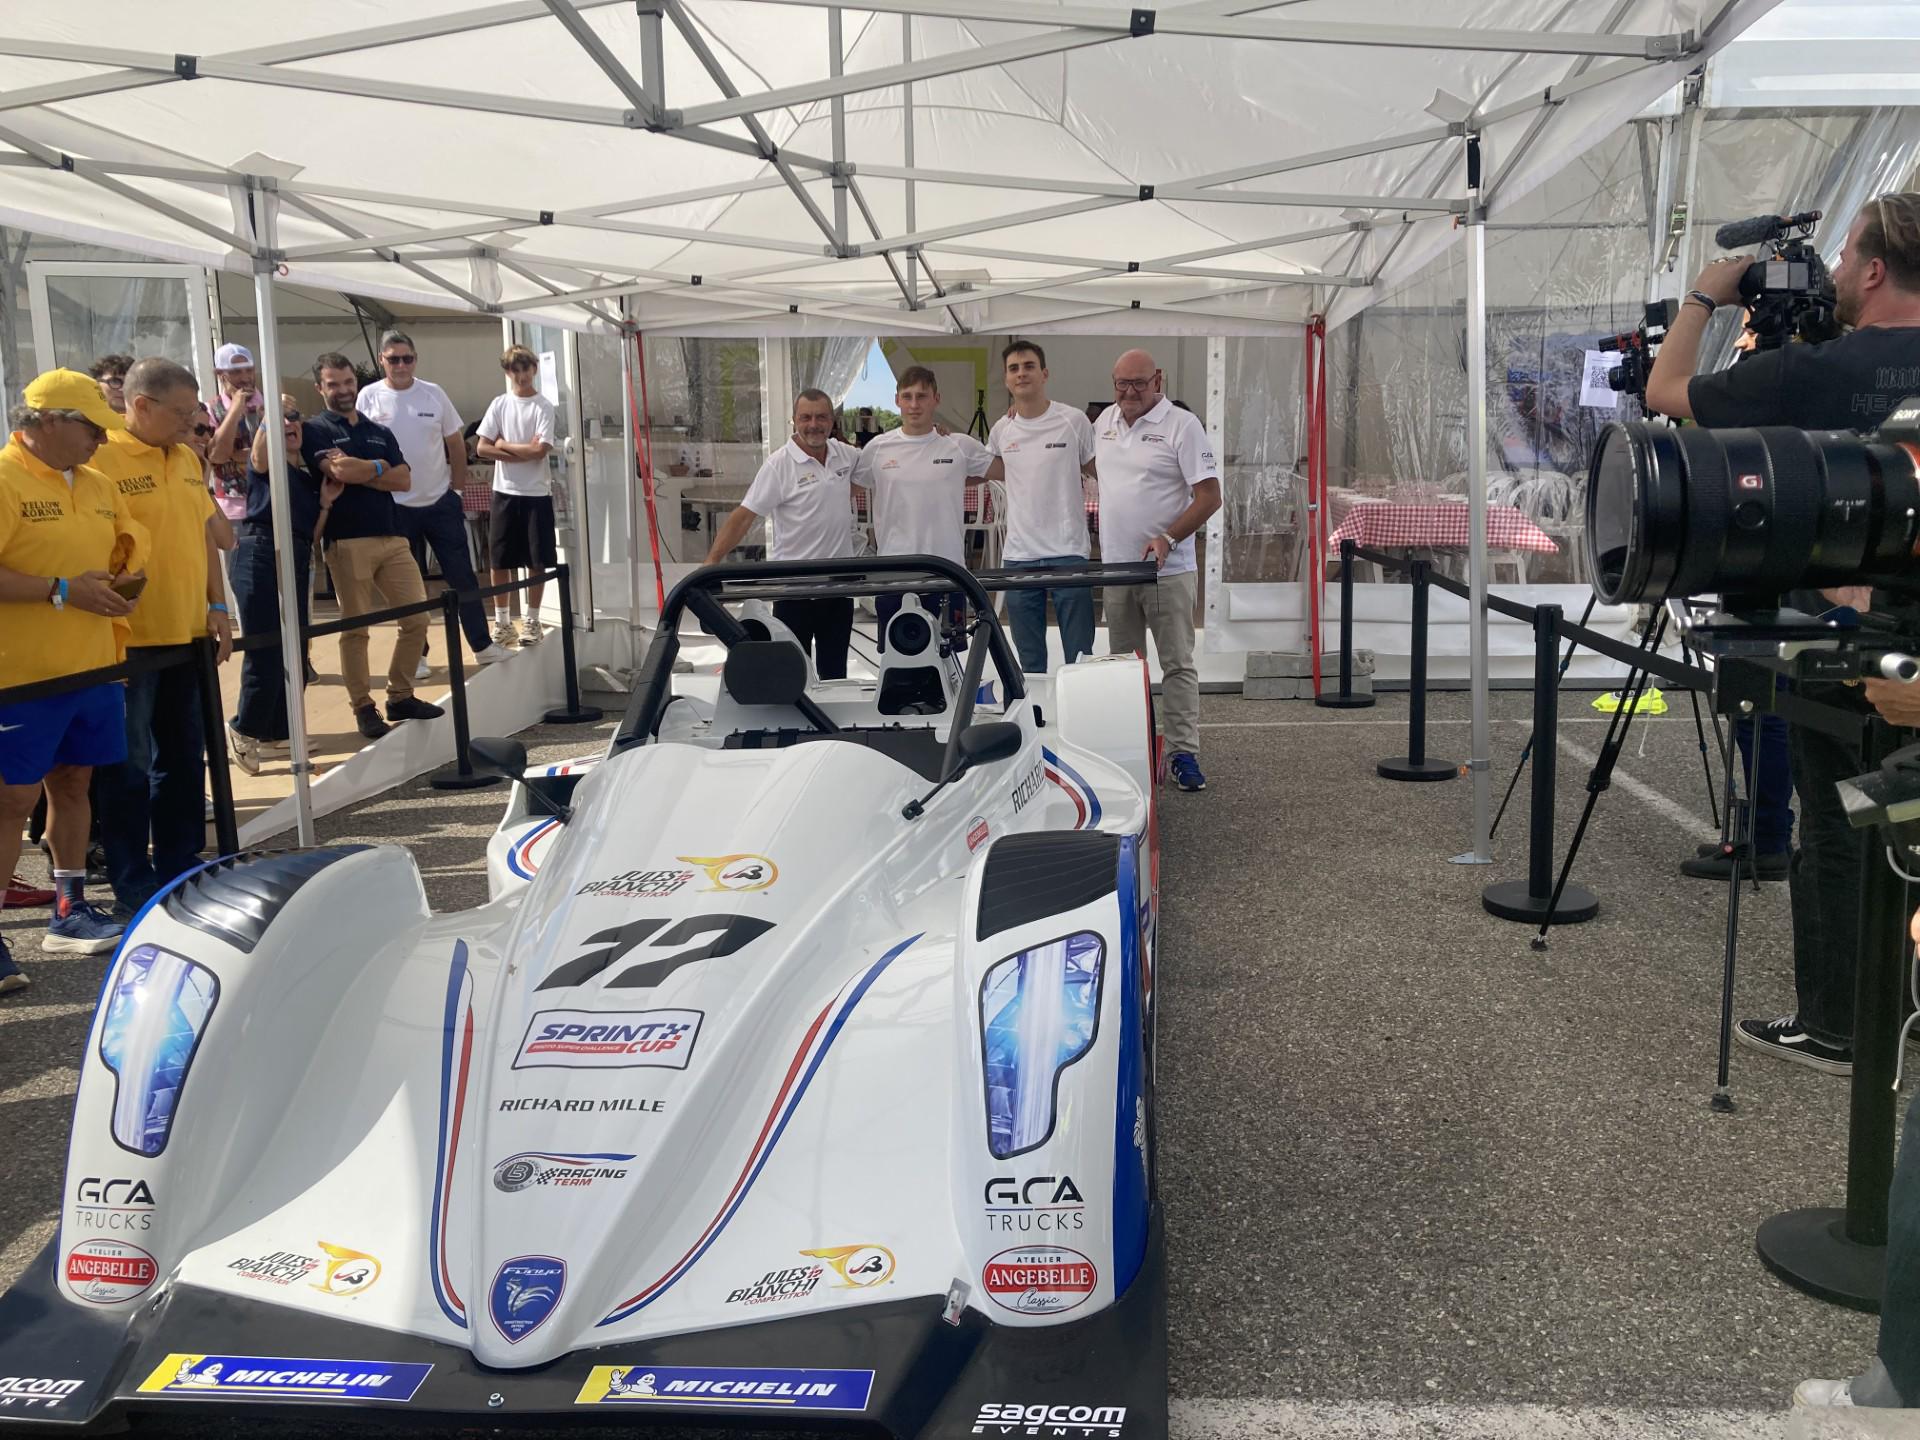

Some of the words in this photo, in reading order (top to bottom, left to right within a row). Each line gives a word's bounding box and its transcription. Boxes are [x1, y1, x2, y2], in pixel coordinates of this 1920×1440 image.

[116, 474, 152, 487] YELLOW
[118, 482, 158, 494] KORNER
[1742, 476, 1758, 488] G
[21, 501, 60, 509] YELLOW
[22, 508, 64, 517] KORNER
[611, 870, 681, 882] JULES
[575, 880, 688, 896] BIANCHI
[535, 1024, 667, 1042] SPRINT
[626, 1041, 677, 1053] CUP
[499, 1098, 595, 1112] RICHARD
[599, 1098, 666, 1113] MILLE
[557, 1168, 627, 1179] RACING
[553, 1178, 592, 1186] TEAM
[984, 1175, 1084, 1205] GCA
[78, 1177, 156, 1205] GCA
[76, 1211, 152, 1231] TRUCKS
[986, 1212, 1084, 1231] TRUCKS
[88, 1248, 122, 1256] ATELIER
[259, 1251, 312, 1268] JULES
[1016, 1256, 1062, 1264] ATELIER
[69, 1258, 150, 1279] ANGEBELLE
[227, 1258, 309, 1281] BIANCHI
[754, 1266, 811, 1287] JULES
[237, 1270, 290, 1286] COMPETITION
[989, 1268, 1090, 1286] ANGEBELLE
[725, 1277, 820, 1304] BIANCHI
[744, 1290, 812, 1306] COMPETITION
[1017, 1287, 1061, 1309] Classic
[224, 1369, 393, 1388] MICHELIN
[664, 1380, 837, 1396] MICHELIN
[977, 1403, 1127, 1426] sagcom
[971, 1425, 1121, 1438] EVENTS
